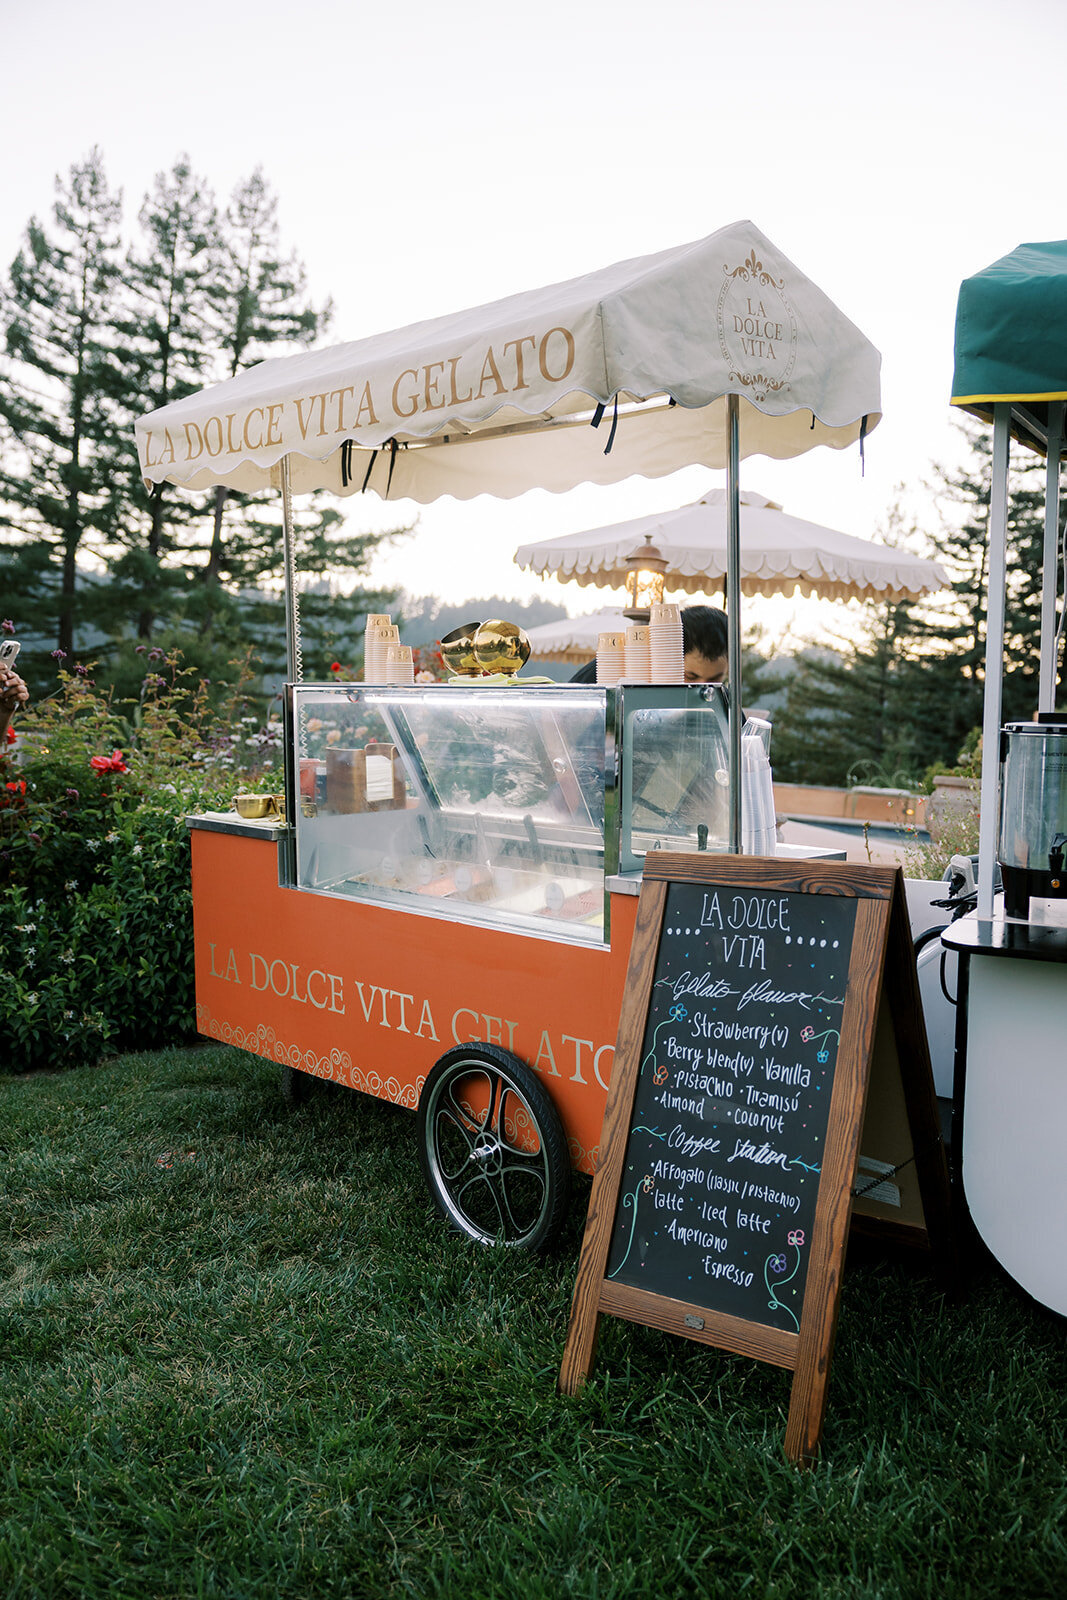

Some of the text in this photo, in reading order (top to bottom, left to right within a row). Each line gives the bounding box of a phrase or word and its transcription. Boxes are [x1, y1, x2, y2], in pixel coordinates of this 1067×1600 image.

[747, 298, 768, 318] LA
[733, 315, 783, 341] DOLCE
[740, 337, 777, 360] VITA
[144, 327, 576, 469] LA DOLCE VITA GELATO
[700, 892, 790, 932] LA DOLCE
[722, 935, 766, 970] VITA
[209, 943, 242, 984] LA
[249, 952, 346, 1015] DOLCE
[355, 981, 440, 1042] VITA
[673, 971, 741, 1001] Gelato
[667, 1036, 704, 1071] Berry
[765, 1057, 811, 1088] Vanilla
[660, 1091, 704, 1120] Almond
[667, 1124, 721, 1157] Coffee
[701, 1201, 728, 1228] Iced
[668, 1218, 728, 1253] Americano
[705, 1255, 754, 1288] Espresso
